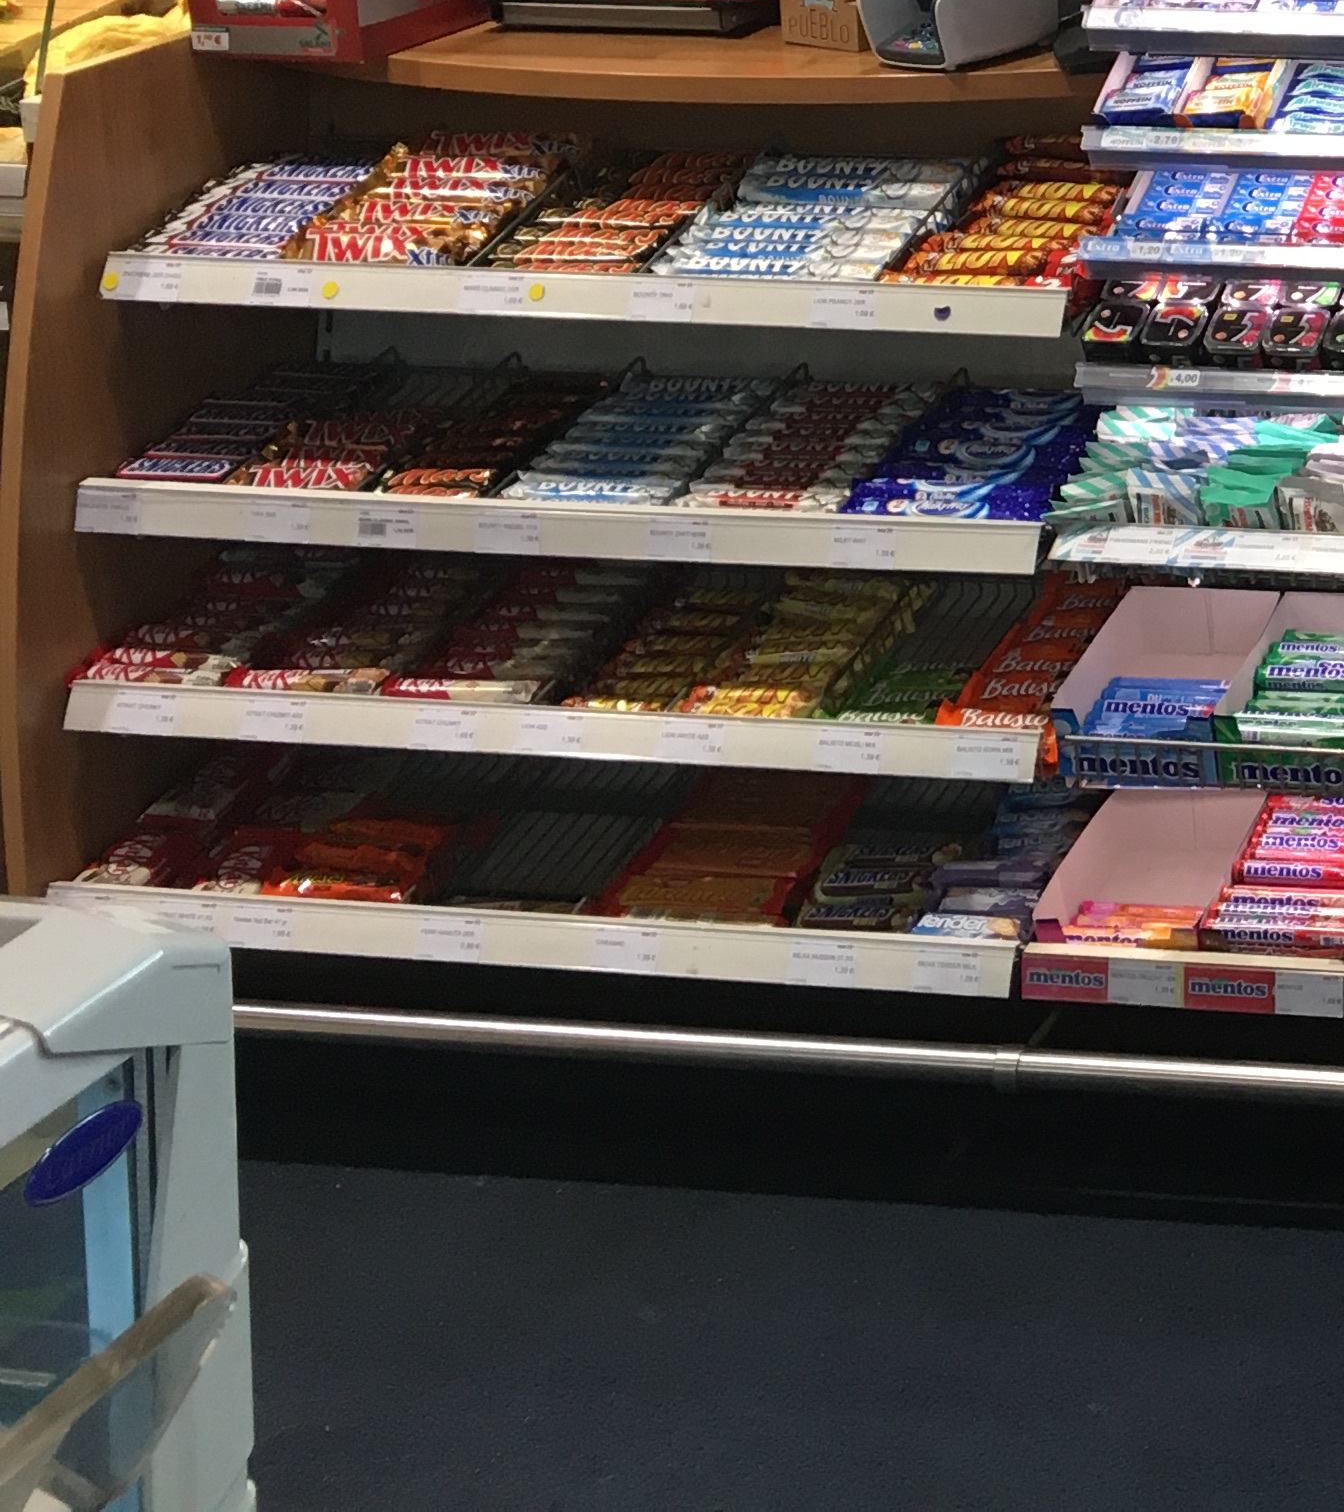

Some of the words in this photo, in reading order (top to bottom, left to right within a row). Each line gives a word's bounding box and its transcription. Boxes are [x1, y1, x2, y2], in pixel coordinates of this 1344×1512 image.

[788, 8, 850, 44] PUEBLO
[938, 251, 1022, 271] LION
[1104, 700, 1189, 717] mentos
[1028, 969, 1104, 989] mentos
